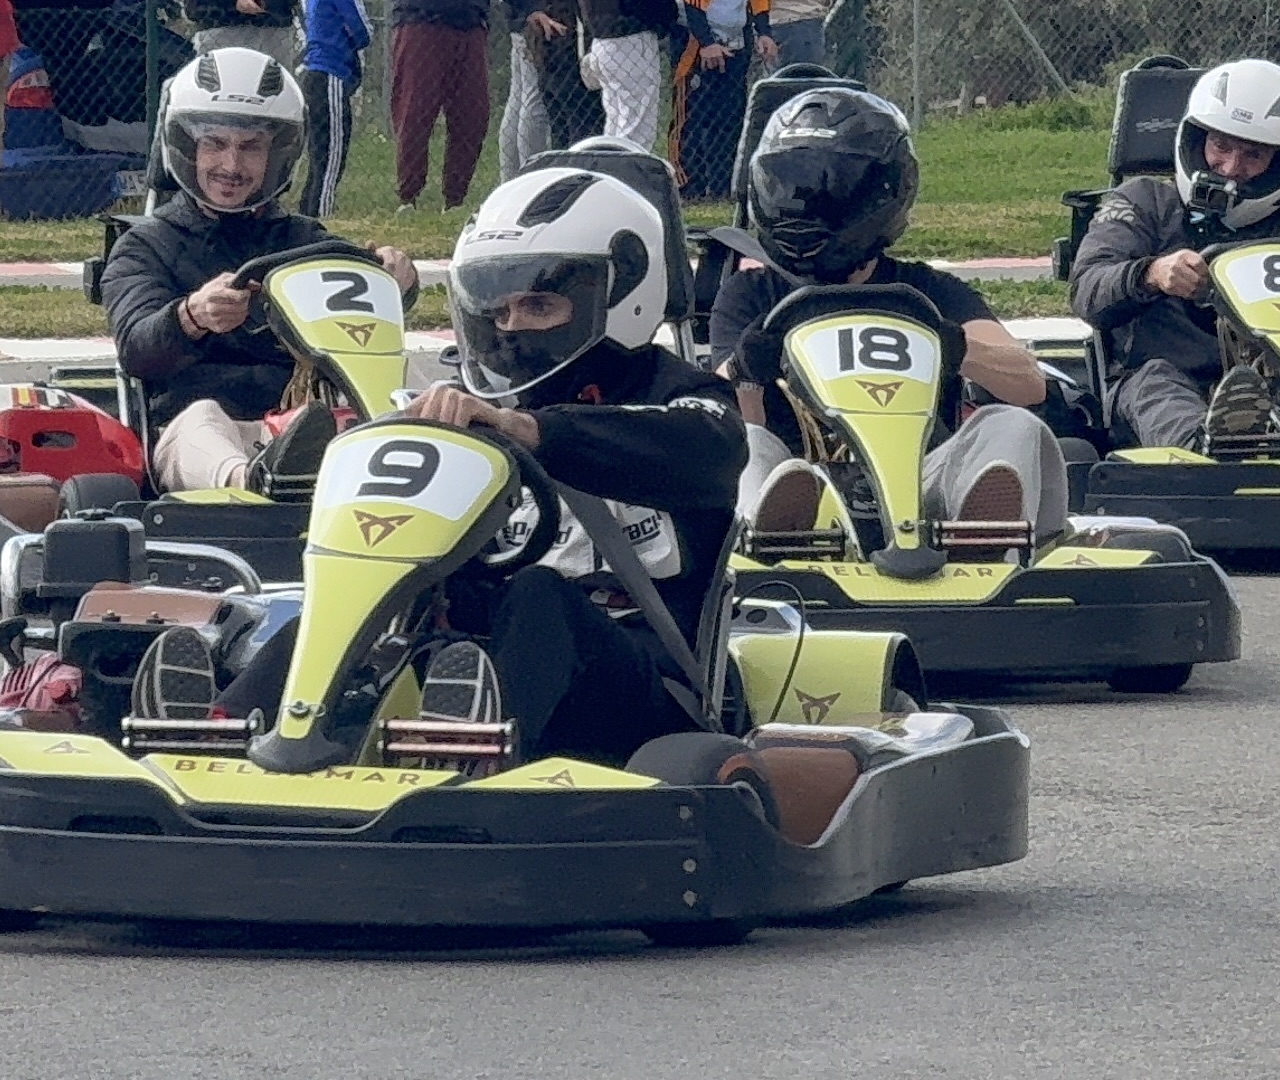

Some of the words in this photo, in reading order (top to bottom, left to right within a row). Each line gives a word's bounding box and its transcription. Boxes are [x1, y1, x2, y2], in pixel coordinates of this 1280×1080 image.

[320, 271, 376, 314] 2
[838, 326, 913, 372] 18
[356, 439, 441, 498] 9
